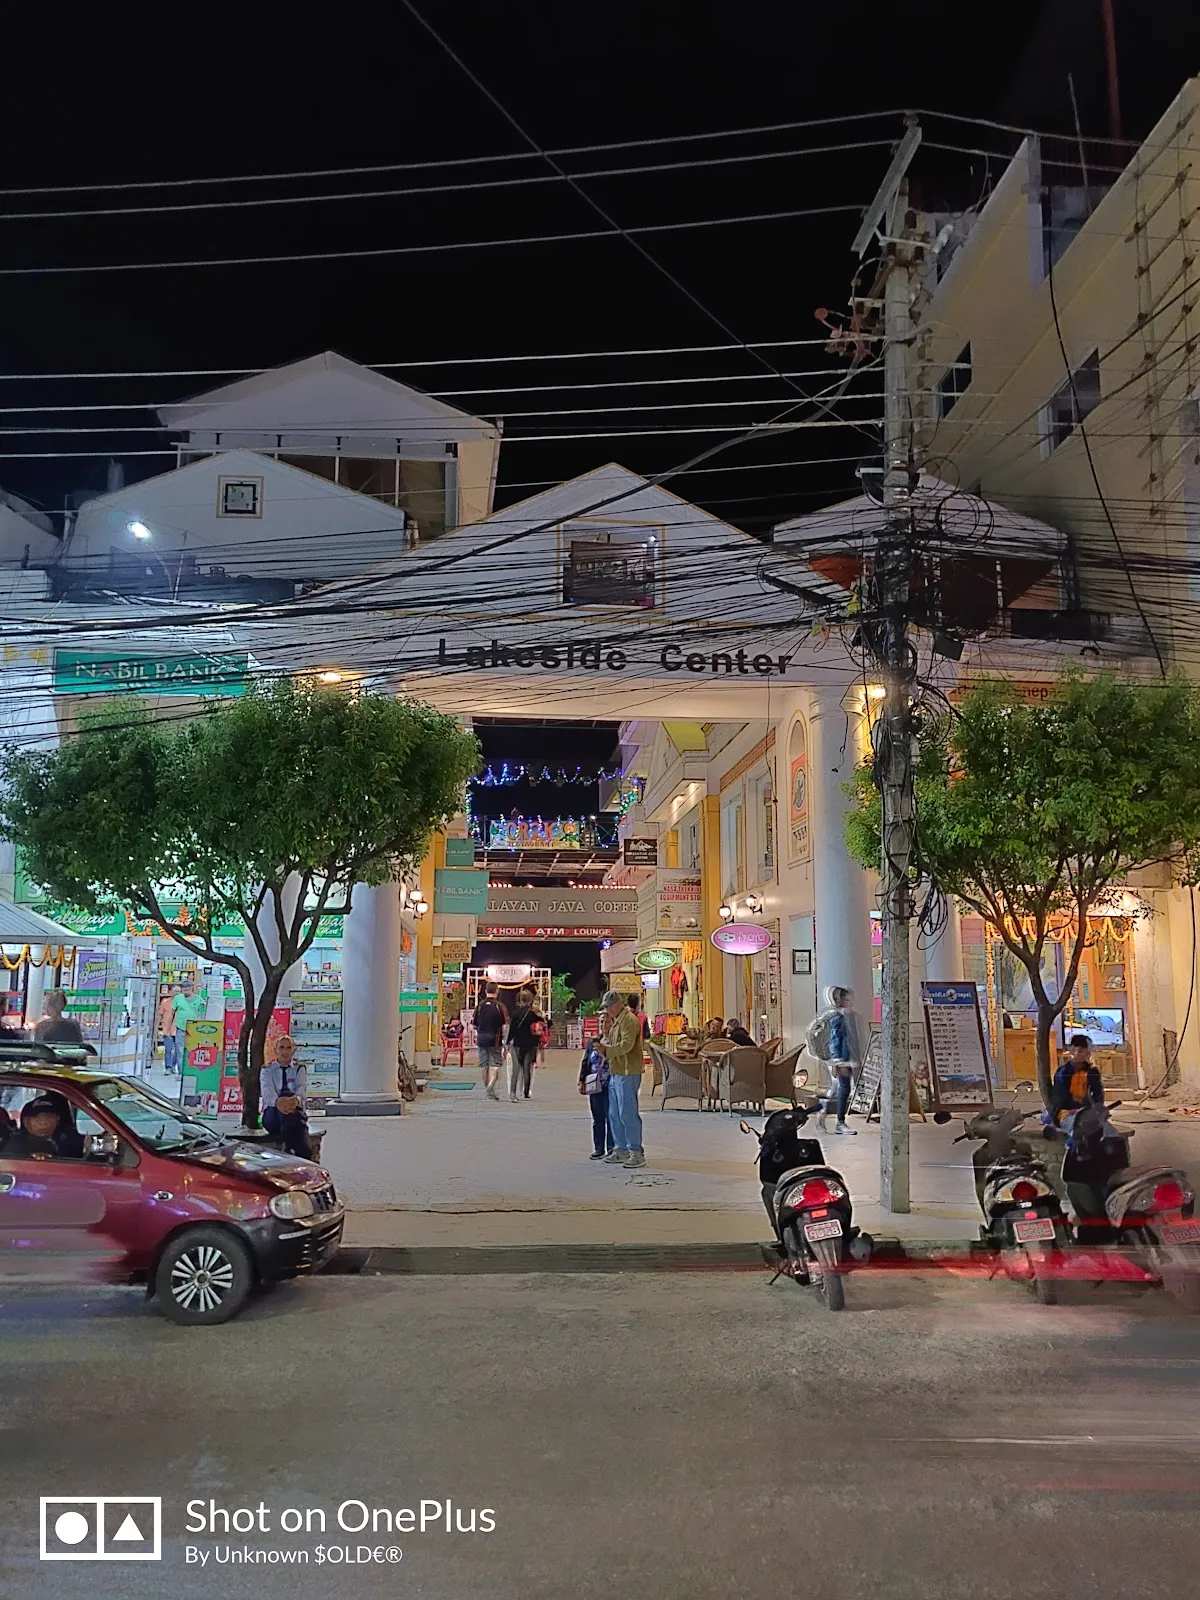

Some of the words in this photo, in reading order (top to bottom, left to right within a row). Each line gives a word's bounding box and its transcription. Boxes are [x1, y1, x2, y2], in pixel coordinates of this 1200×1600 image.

[438, 638, 627, 671] Lakeside
[660, 643, 791, 675] Center
[155, 663, 226, 682] BANK
[458, 887, 482, 896] BANK
[487, 900, 540, 913] LAYAN
[547, 900, 586, 913] JAVA
[593, 900, 639, 913] COFFE
[486, 927, 500, 935] 24
[501, 927, 526, 935] HOUR
[573, 928, 612, 936] LOUNGE
